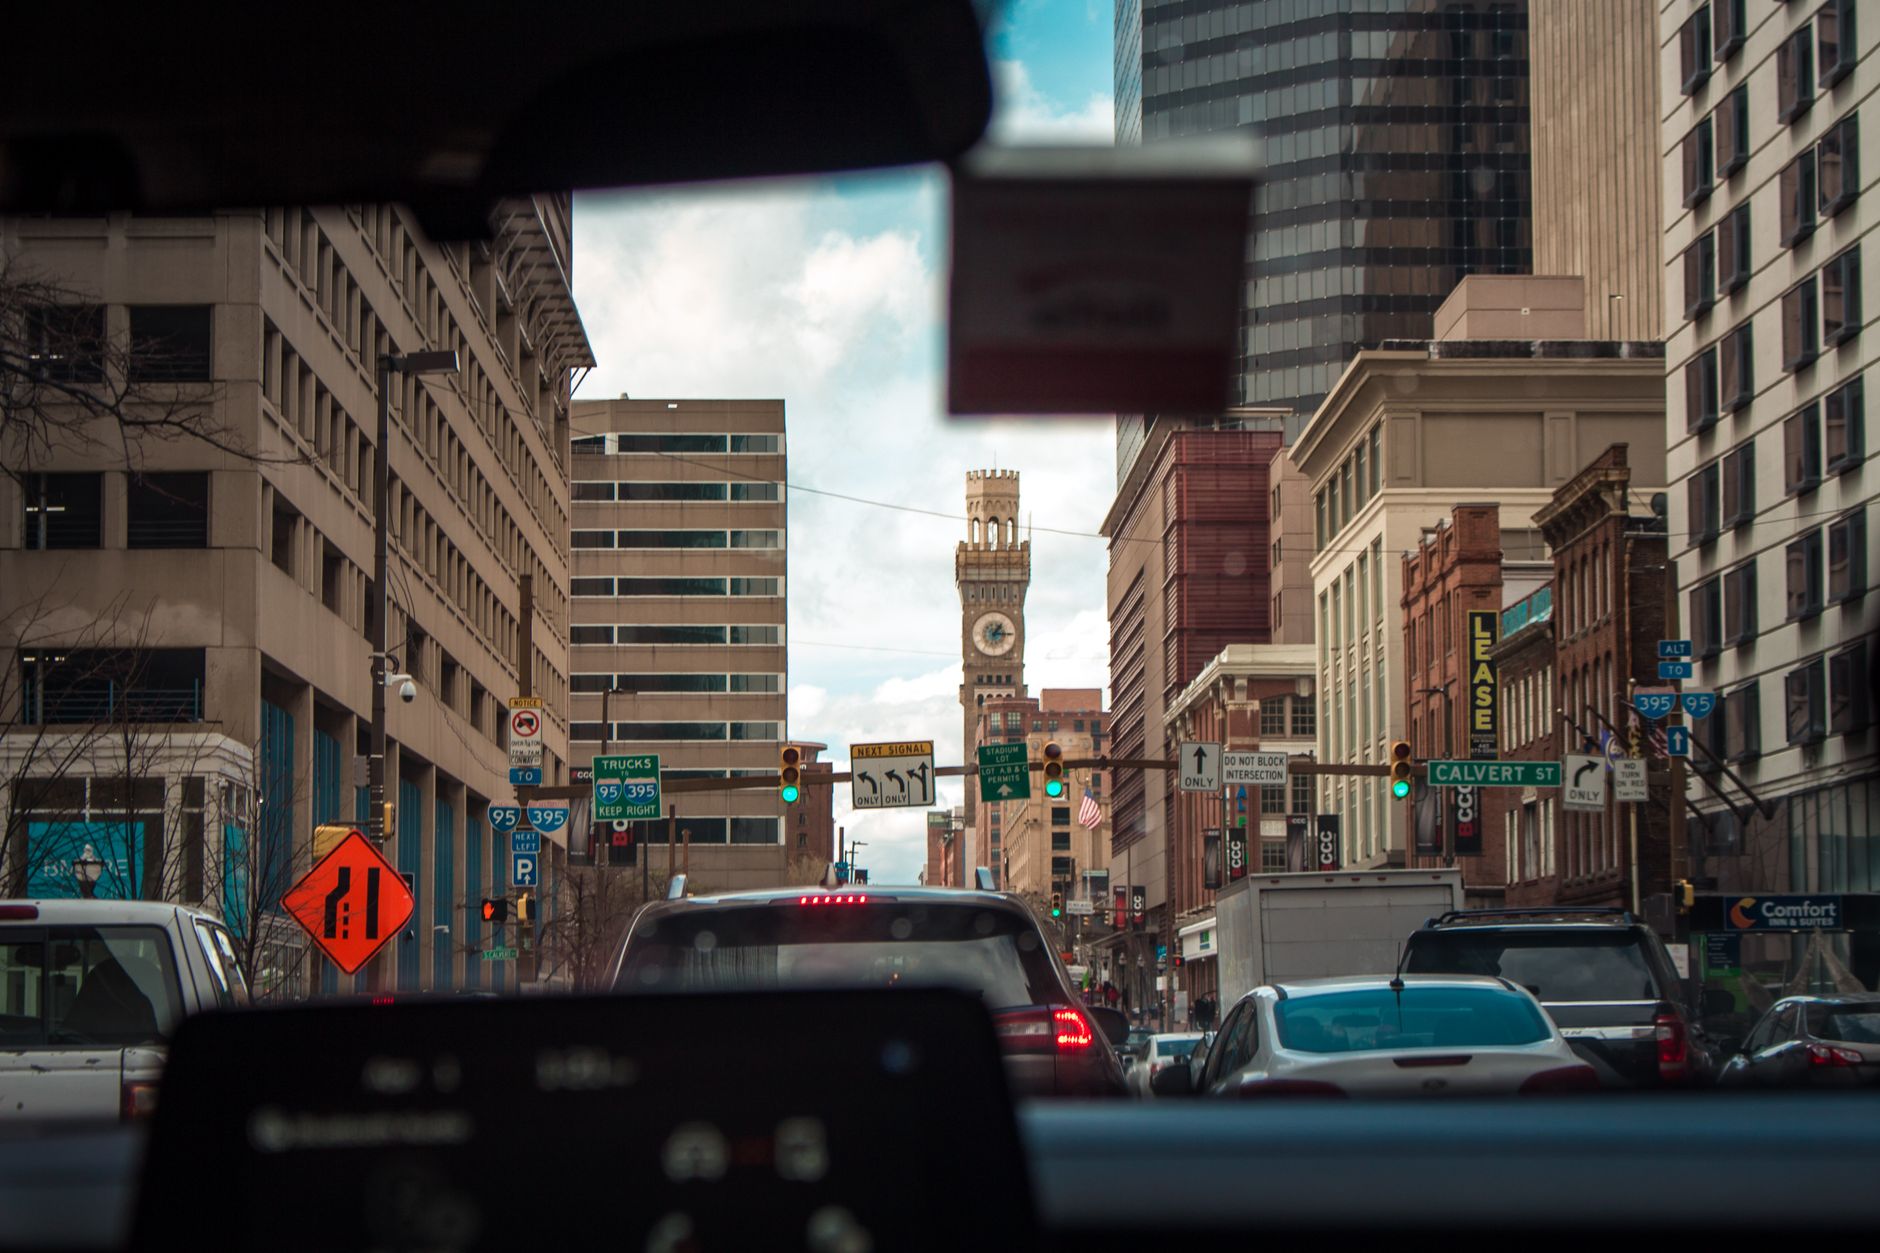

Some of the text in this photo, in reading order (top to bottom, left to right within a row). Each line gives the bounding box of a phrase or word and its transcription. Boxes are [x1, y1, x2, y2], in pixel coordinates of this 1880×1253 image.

[1665, 644, 1685, 654] ALT
[1473, 616, 1494, 730] LEASE
[1667, 665, 1684, 675] TO
[1640, 696, 1670, 711] 395
[1686, 696, 1710, 712] 95
[857, 743, 925, 756] NEXT SIGNAL
[985, 746, 1019, 756] STADIUM
[511, 756, 533, 764] CONWAY
[601, 758, 651, 770] TRUCKS
[995, 755, 1009, 763] LOT
[1224, 756, 1284, 767] DO NOT BLOCK
[517, 771, 533, 782] TO
[981, 767, 995, 776] LOT
[1226, 770, 1283, 780] INTERSECTION
[1436, 764, 1554, 782] CALVERT ST
[987, 774, 1020, 784] PERMITS
[1185, 777, 1214, 787] ONLY
[599, 785, 618, 798] 95
[628, 784, 655, 799] 395
[1569, 789, 1600, 801] ONLY
[857, 796, 879, 805] ONLY
[885, 795, 907, 804] ONLY
[599, 804, 656, 817] KEEP RIGHT
[492, 810, 516, 826] 95
[532, 810, 564, 825] 395
[515, 833, 536, 841] NEXT
[43, 858, 127, 877] BMRE
[517, 859, 533, 880] P
[1761, 900, 1837, 918] Comfort
[1768, 917, 1835, 926] INN & SUITES
